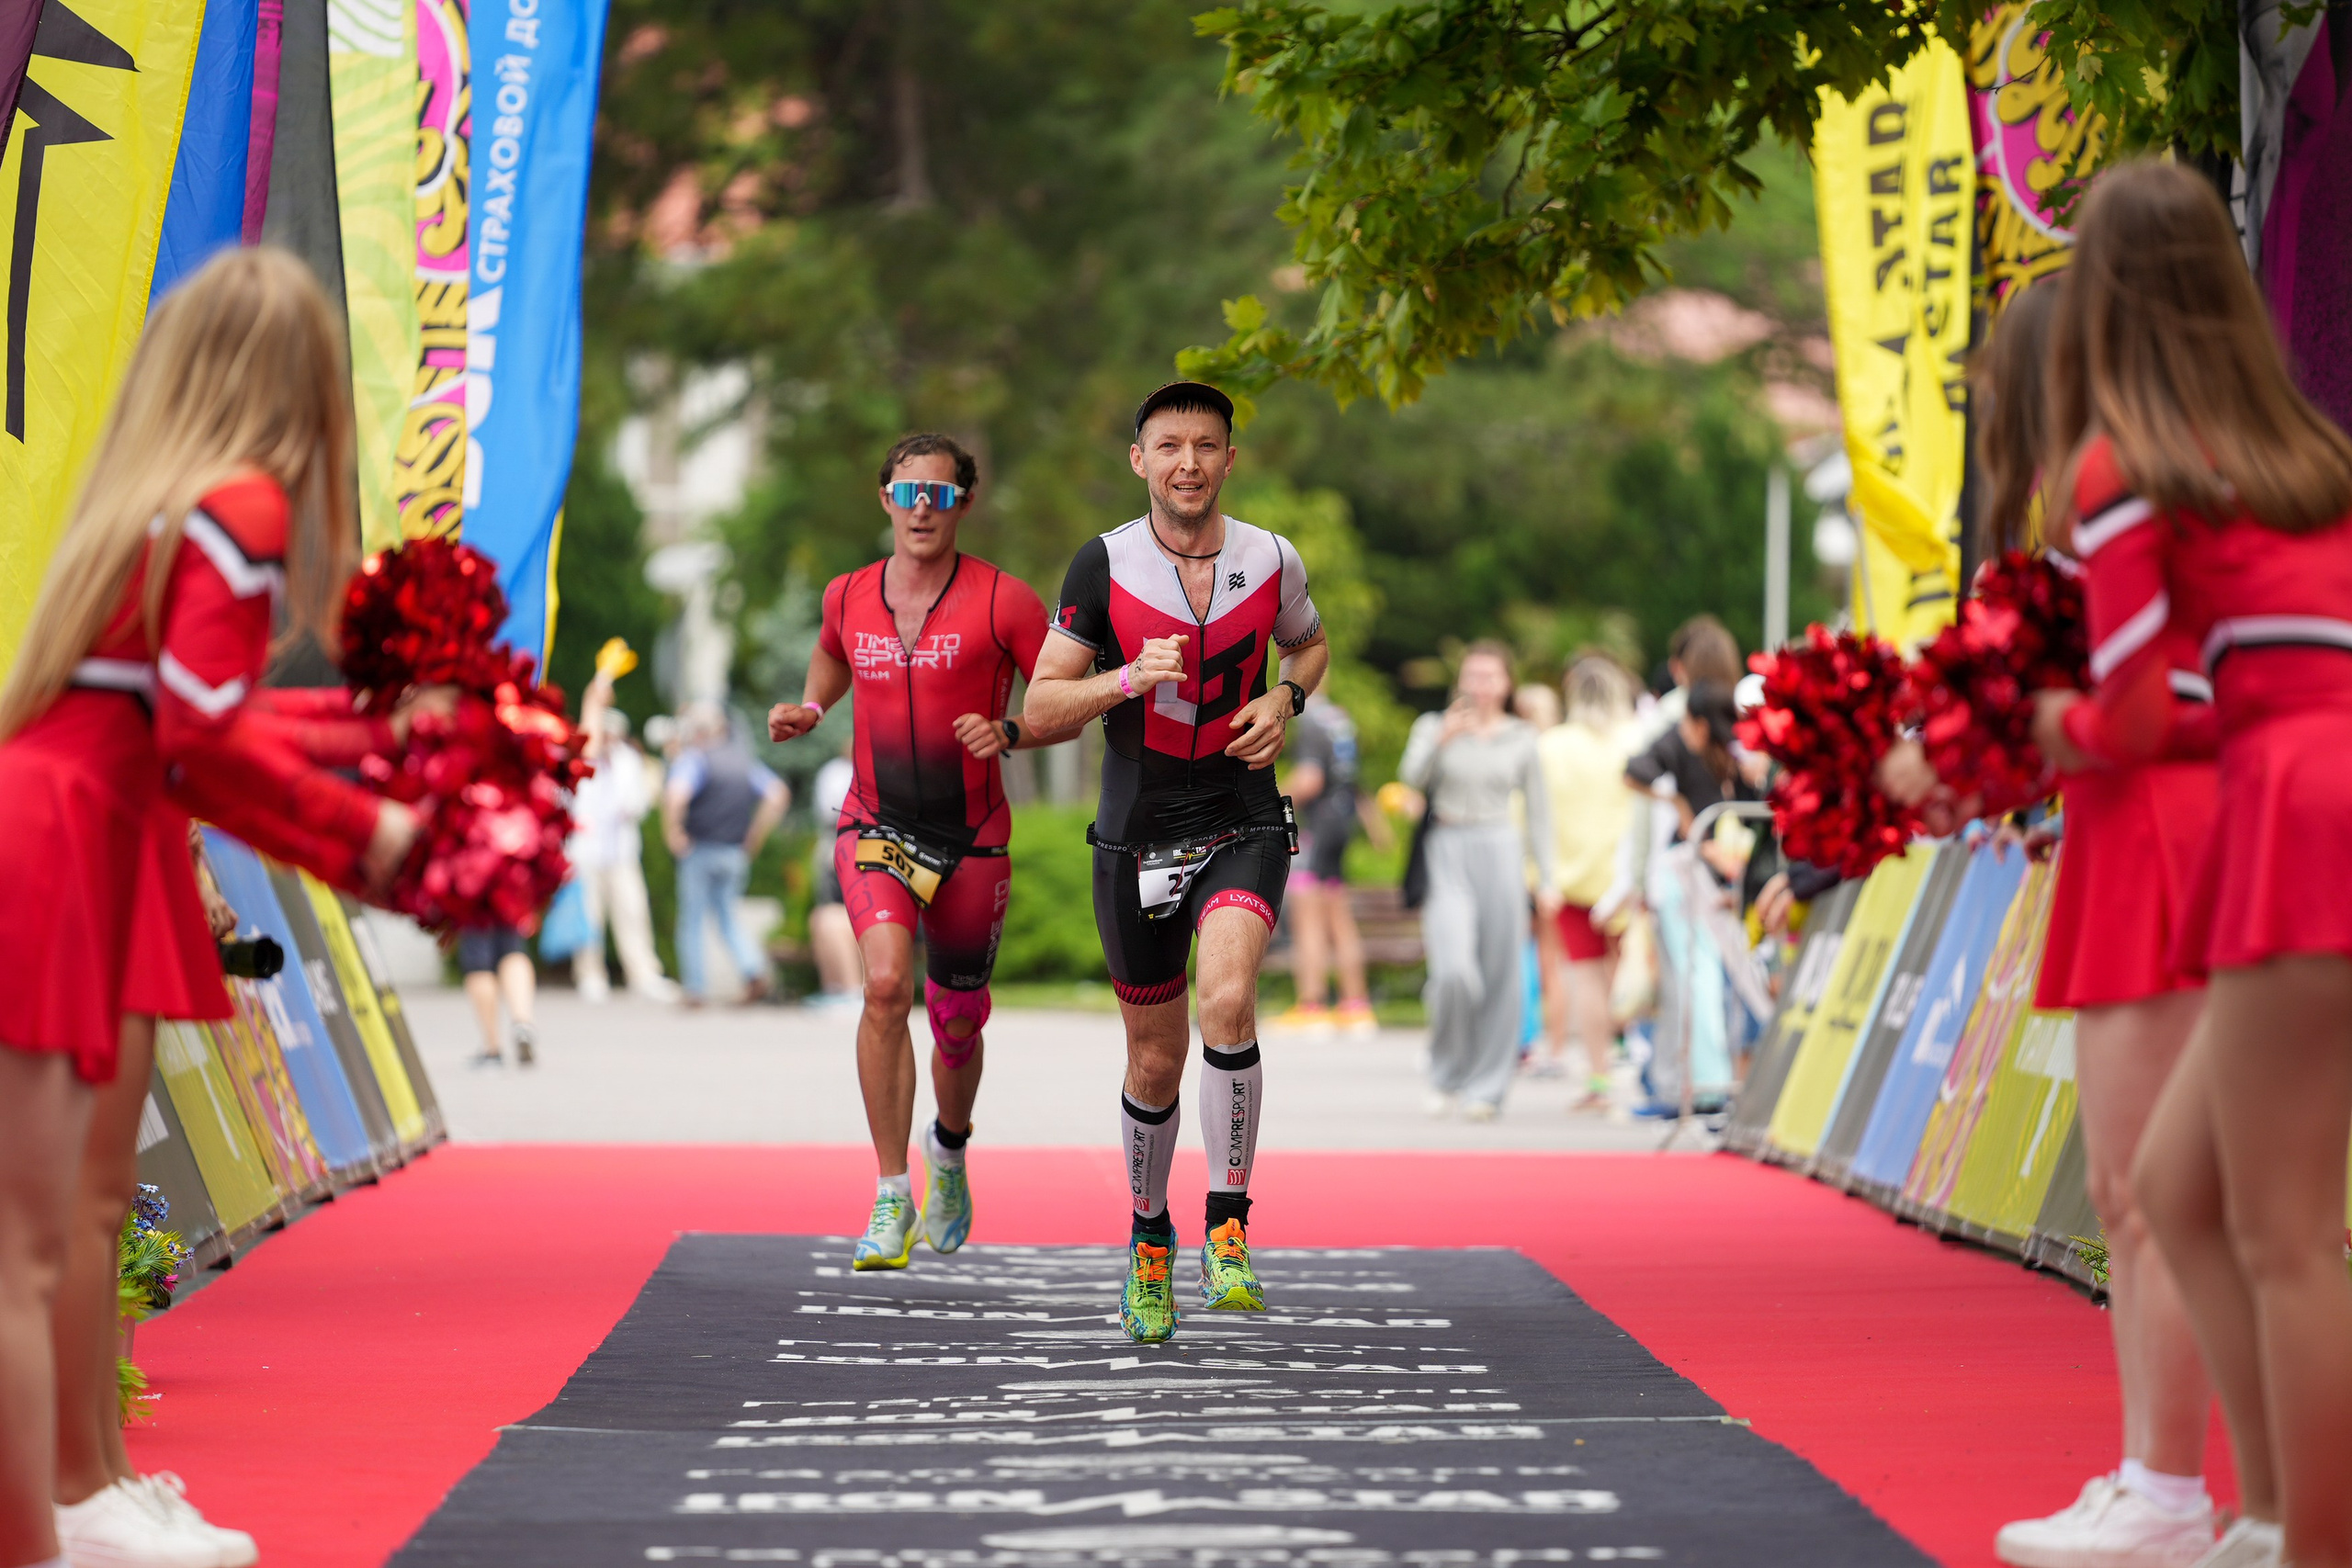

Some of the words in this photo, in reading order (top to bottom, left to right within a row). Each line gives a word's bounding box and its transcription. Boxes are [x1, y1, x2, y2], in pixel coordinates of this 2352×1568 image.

[477, 54, 532, 284] СТРАХОВОЙ
[854, 632, 904, 651] TIME
[929, 633, 961, 650] TO
[854, 649, 959, 670] SPORT
[857, 670, 890, 681] TEAM
[882, 845, 916, 880] 507
[800, 1305, 1049, 1319] IRON
[1185, 1314, 1451, 1326] STAR
[776, 1353, 1049, 1363] IRON
[1200, 1358, 1488, 1372] STAR
[736, 1409, 1036, 1424] IRON
[1201, 1403, 1521, 1415] STAR
